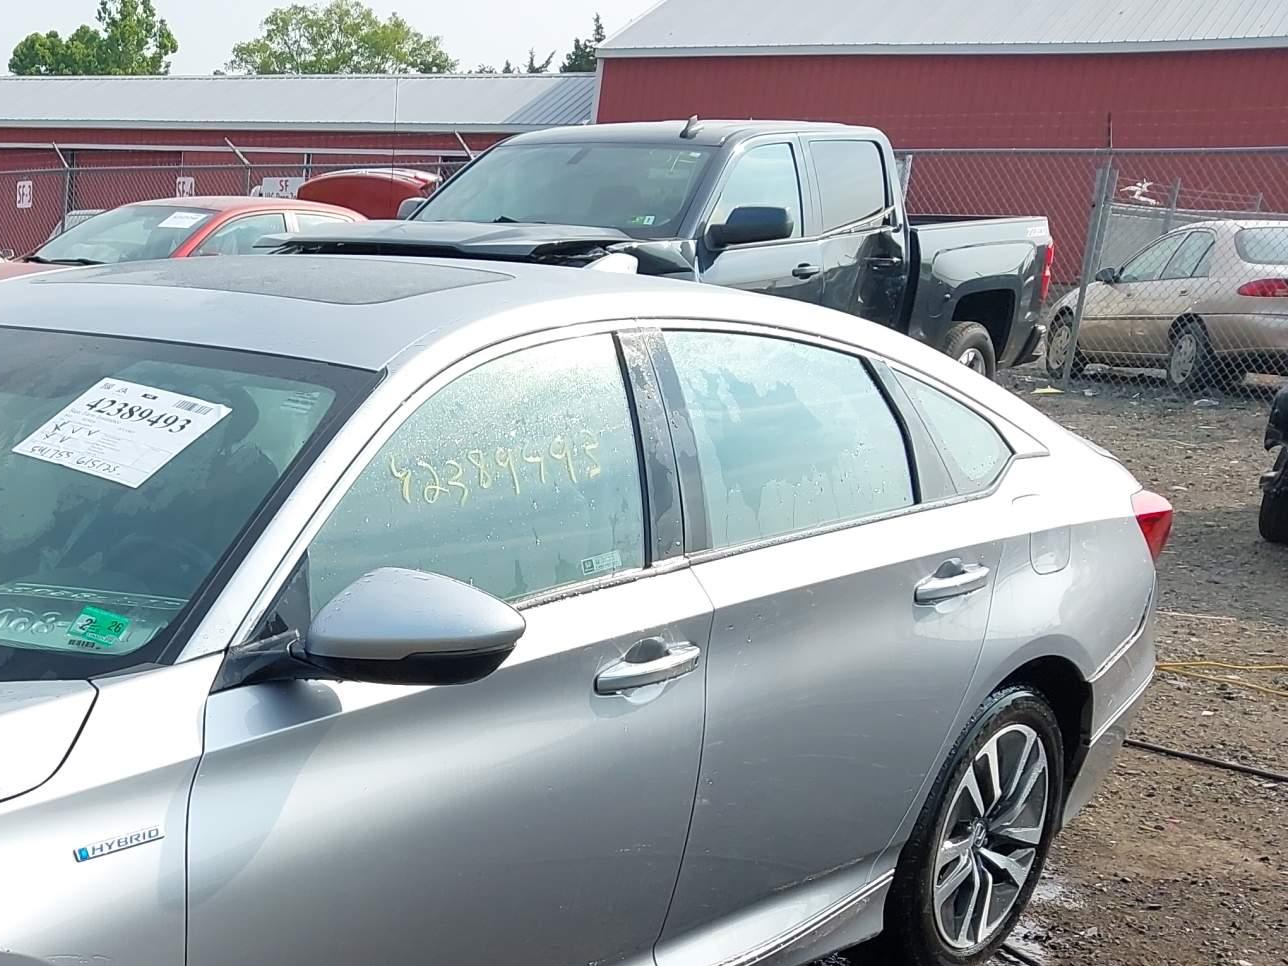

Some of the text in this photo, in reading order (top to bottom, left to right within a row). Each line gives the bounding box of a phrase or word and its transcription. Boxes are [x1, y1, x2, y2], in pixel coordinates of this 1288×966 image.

[85, 397, 192, 433] 42389493
[107, 620, 124, 633] 26
[91, 828, 160, 856] HYBRID
